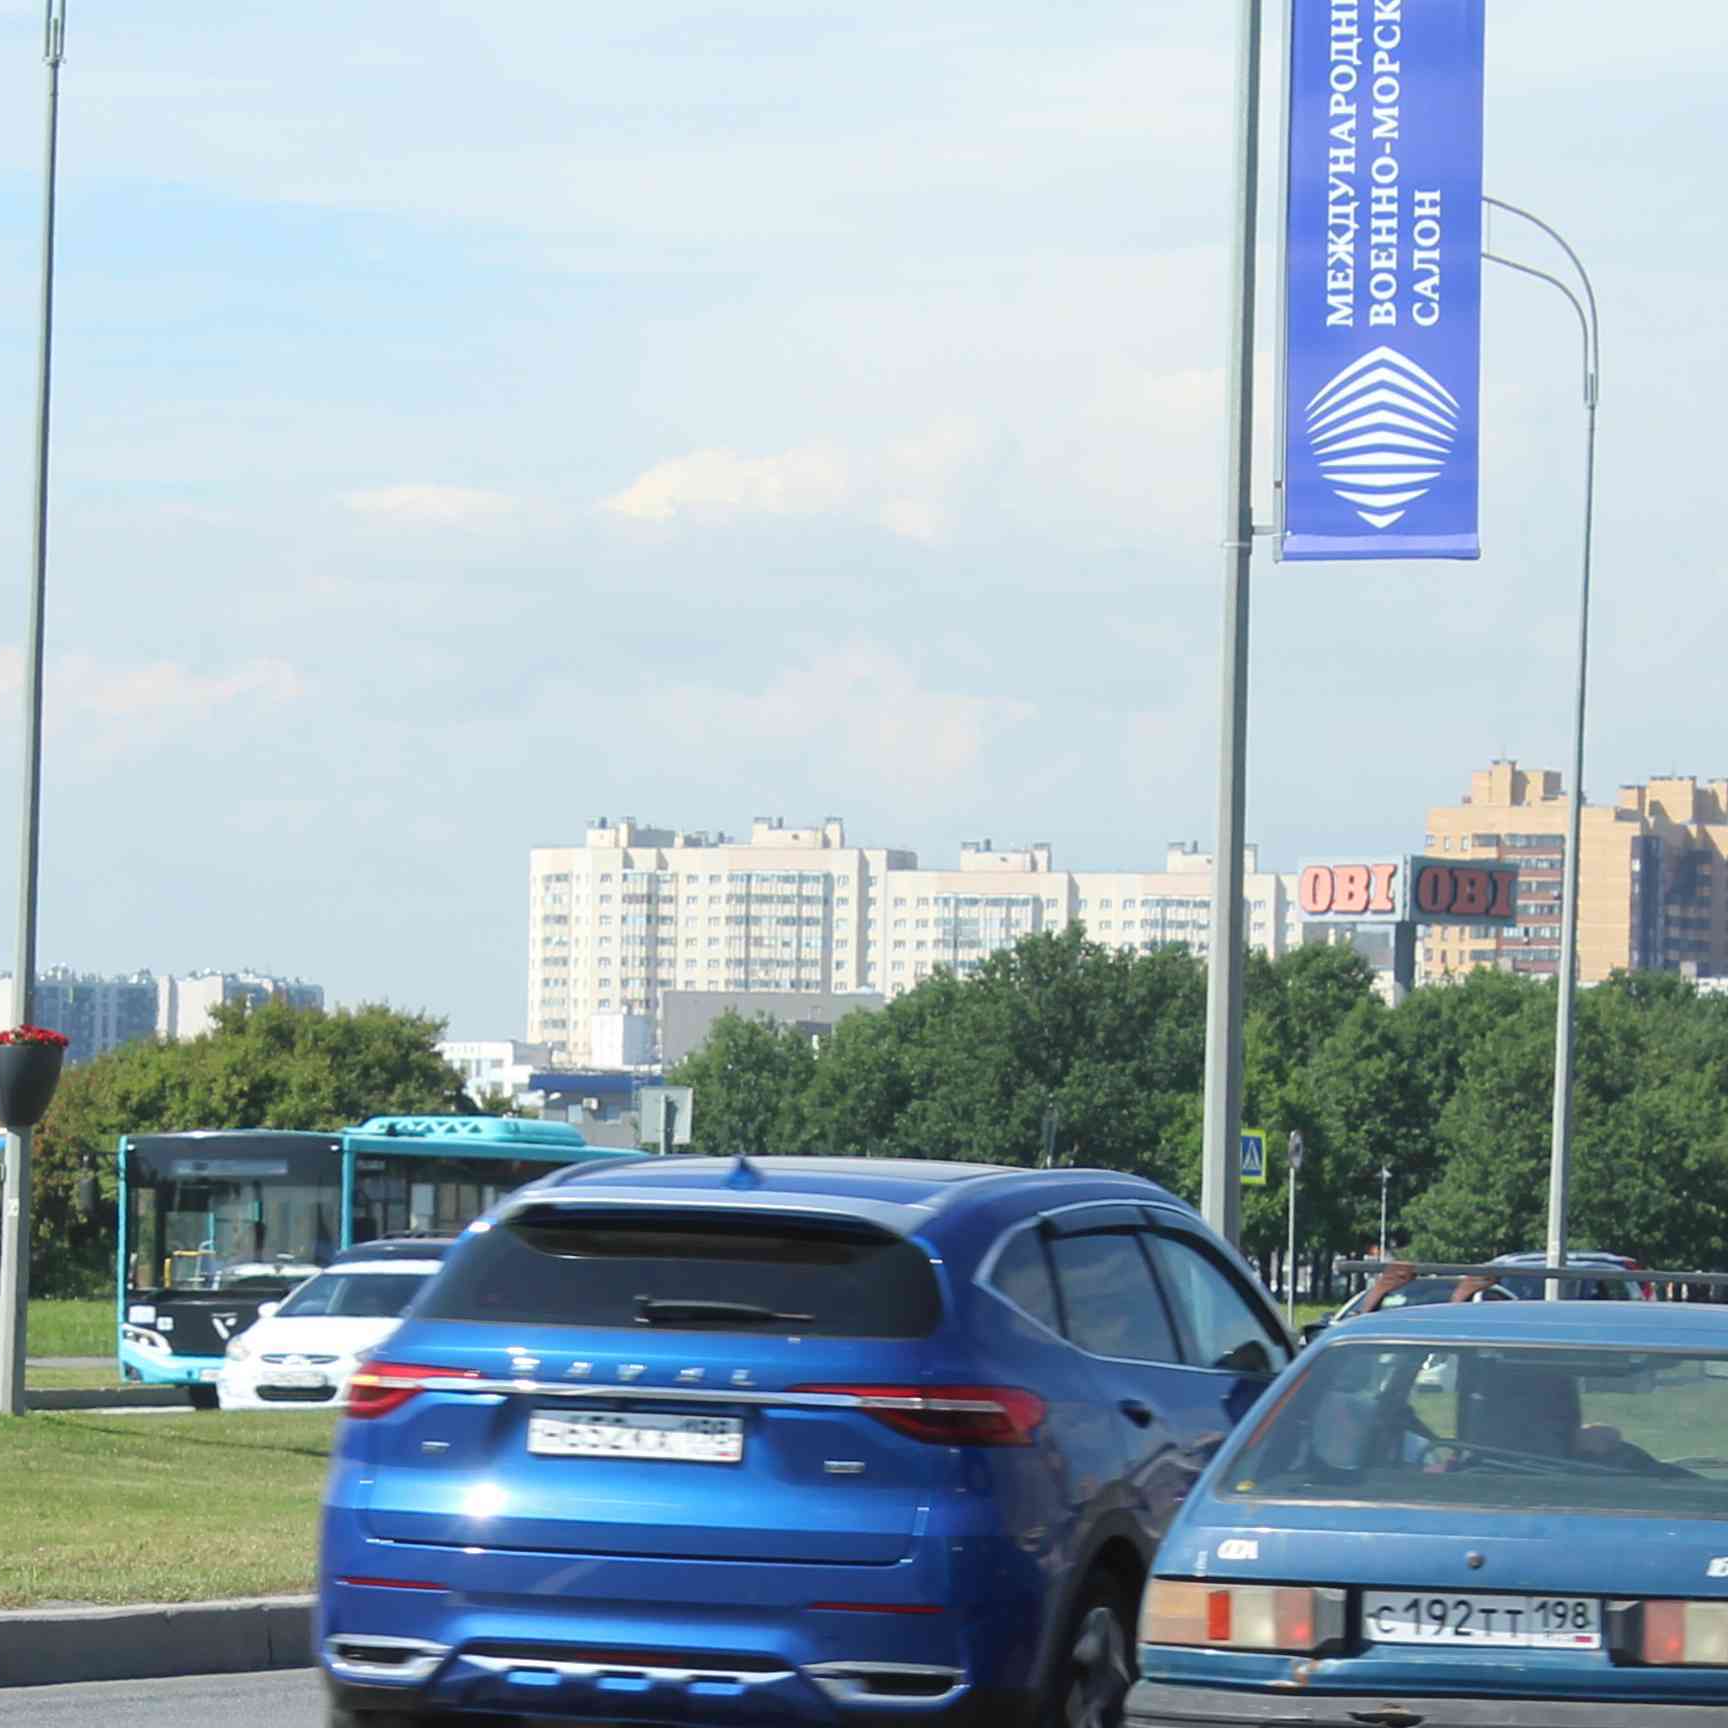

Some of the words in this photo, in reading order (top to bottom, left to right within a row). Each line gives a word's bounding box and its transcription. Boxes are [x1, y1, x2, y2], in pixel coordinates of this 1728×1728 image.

[1326, 0, 1363, 327] МЕЖДУНАРОДН
[1413, 189, 1442, 327] САЛОН
[1301, 864, 1397, 913] OBI
[1419, 867, 1516, 917] OBI
[1533, 1601, 1590, 1629] 198
